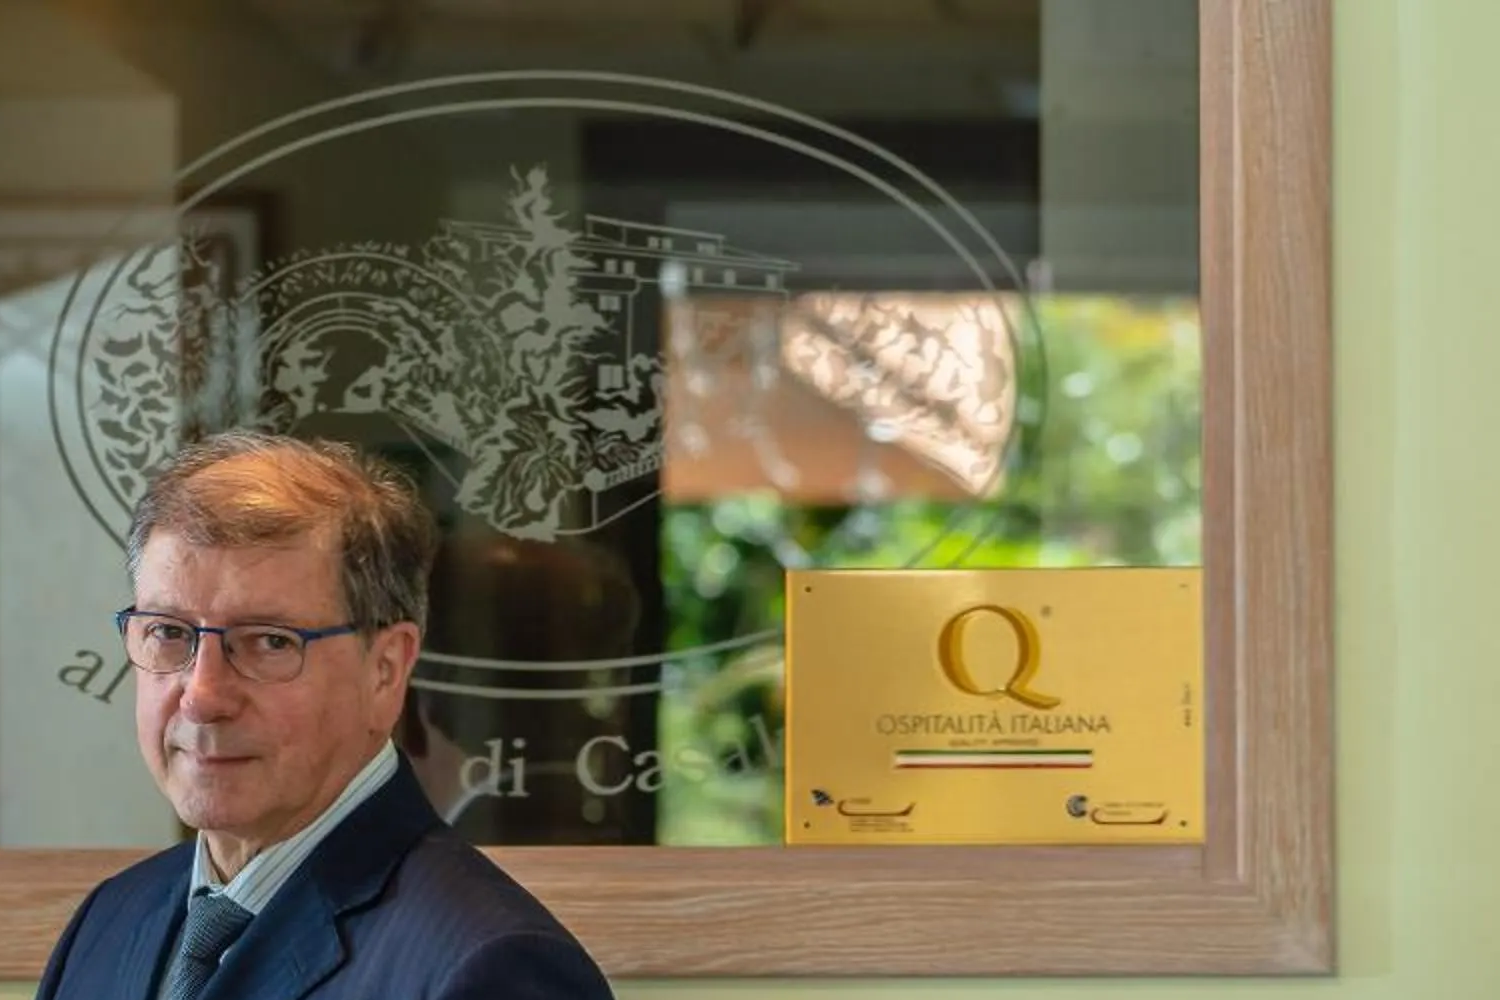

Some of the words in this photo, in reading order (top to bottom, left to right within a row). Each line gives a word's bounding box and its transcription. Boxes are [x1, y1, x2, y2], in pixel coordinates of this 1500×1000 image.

[938, 604, 1061, 710] Q
[460, 737, 529, 798] di
[575, 713, 784, 797] Casal
[876, 710, 1004, 735] OSPITALITÀ
[1010, 715, 1111, 734] ITALIANA
